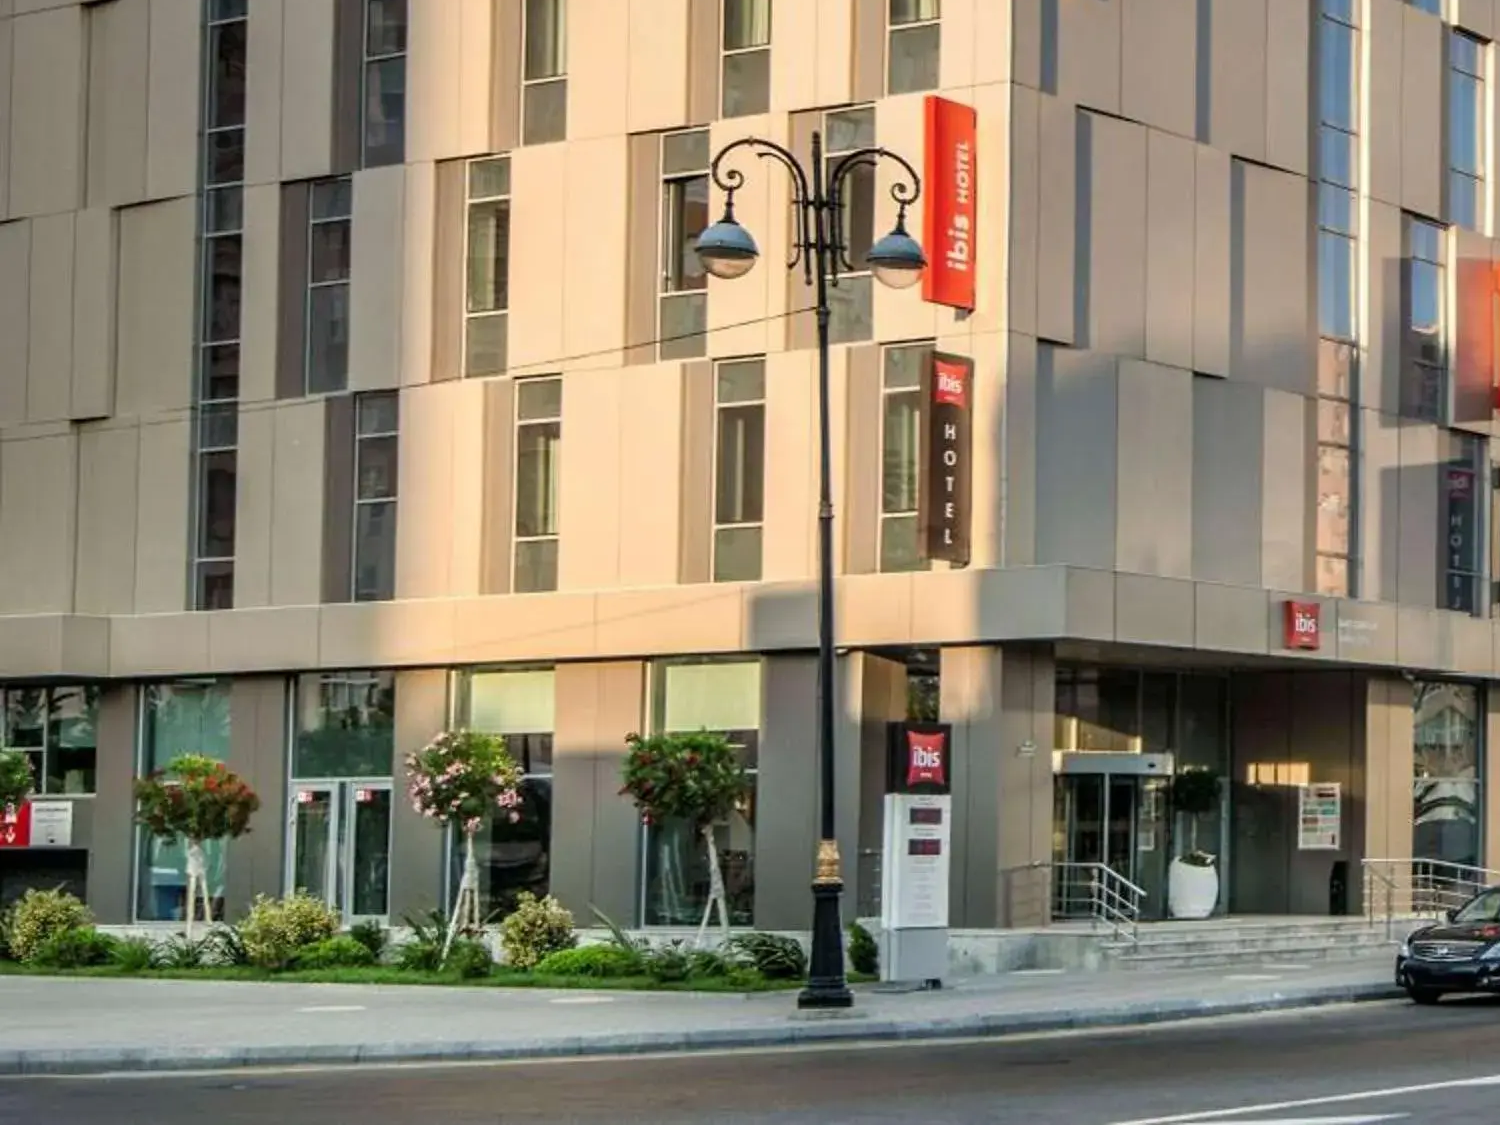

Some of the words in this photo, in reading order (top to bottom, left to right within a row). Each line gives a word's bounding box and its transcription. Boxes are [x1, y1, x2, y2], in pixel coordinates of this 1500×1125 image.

[955, 139, 970, 205] HOTEL
[946, 213, 970, 271] ibis
[937, 371, 963, 394] ibis
[943, 423, 958, 545] HOTEL
[1295, 611, 1316, 633] ibis
[912, 746, 941, 768] ibis
